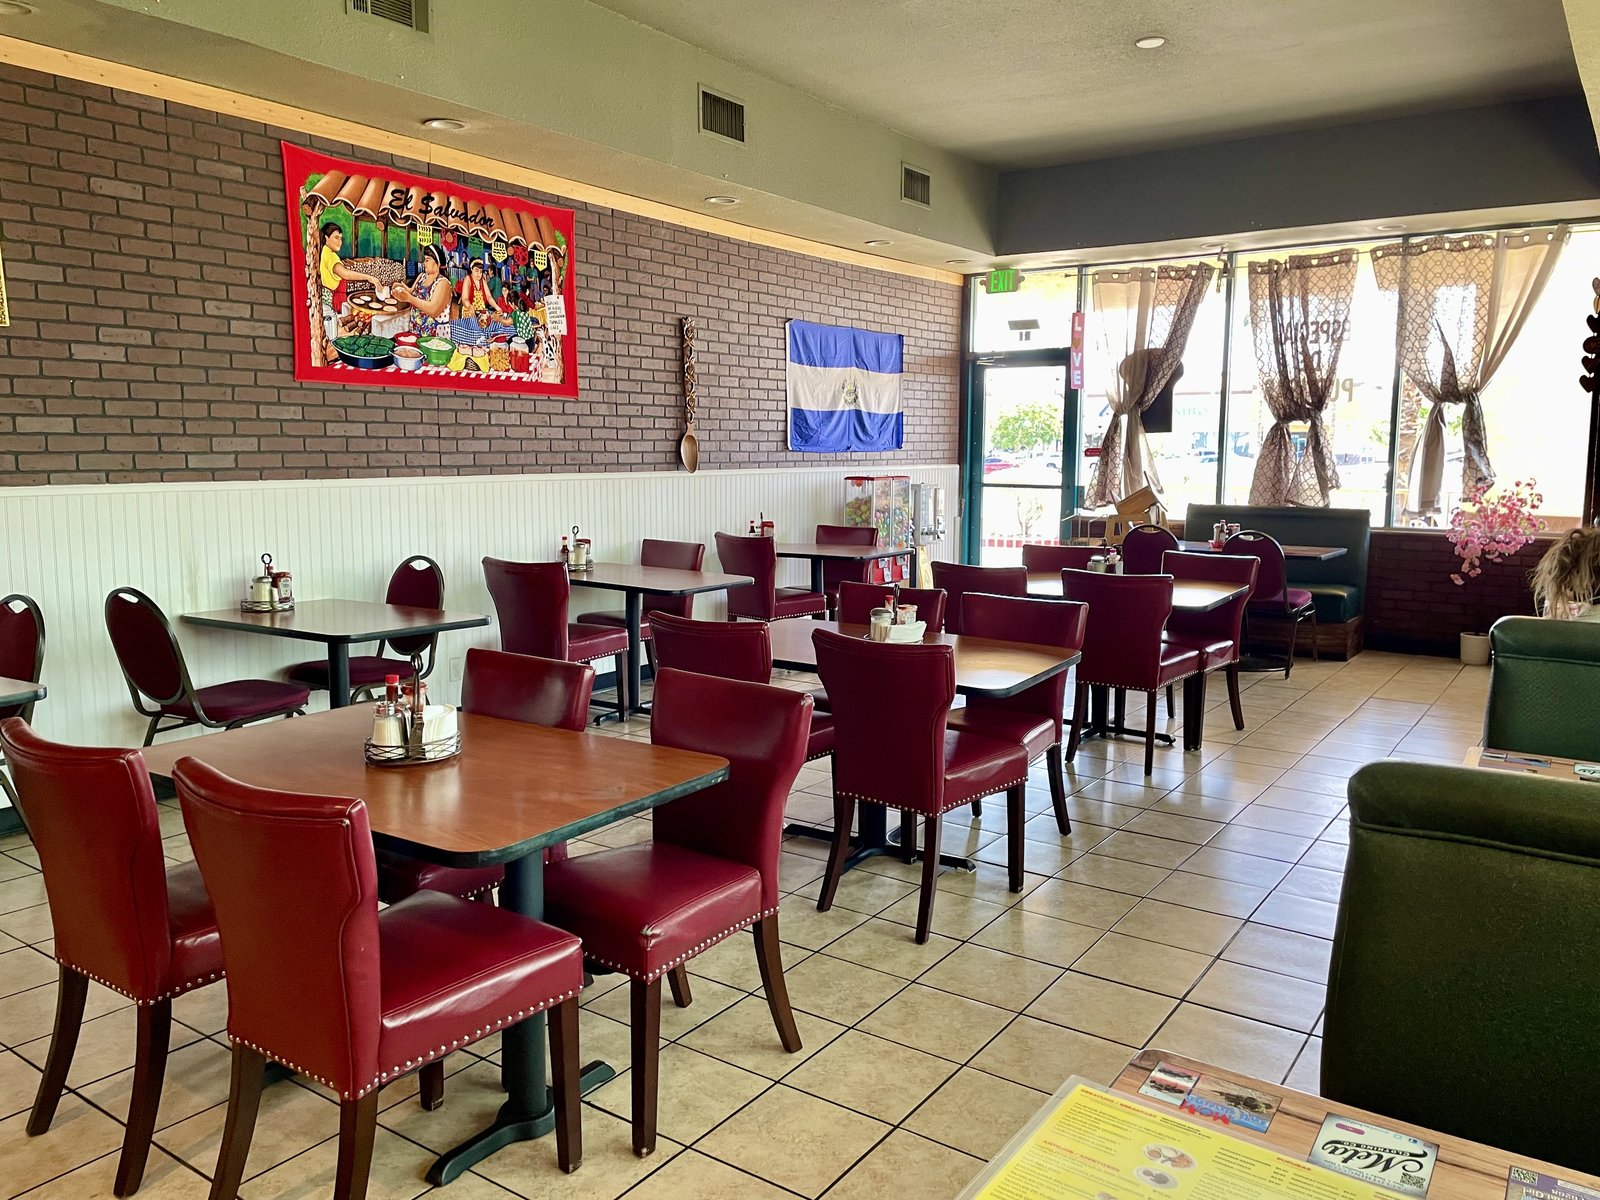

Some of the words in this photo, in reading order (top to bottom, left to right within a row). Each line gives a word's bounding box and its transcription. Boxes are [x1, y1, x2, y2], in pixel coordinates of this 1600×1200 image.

[389, 188, 413, 210] El
[990, 270, 1014, 292] EXIT
[1322, 1144, 1423, 1173] Meta
[1360, 1144, 1410, 1157] CLOTHING
